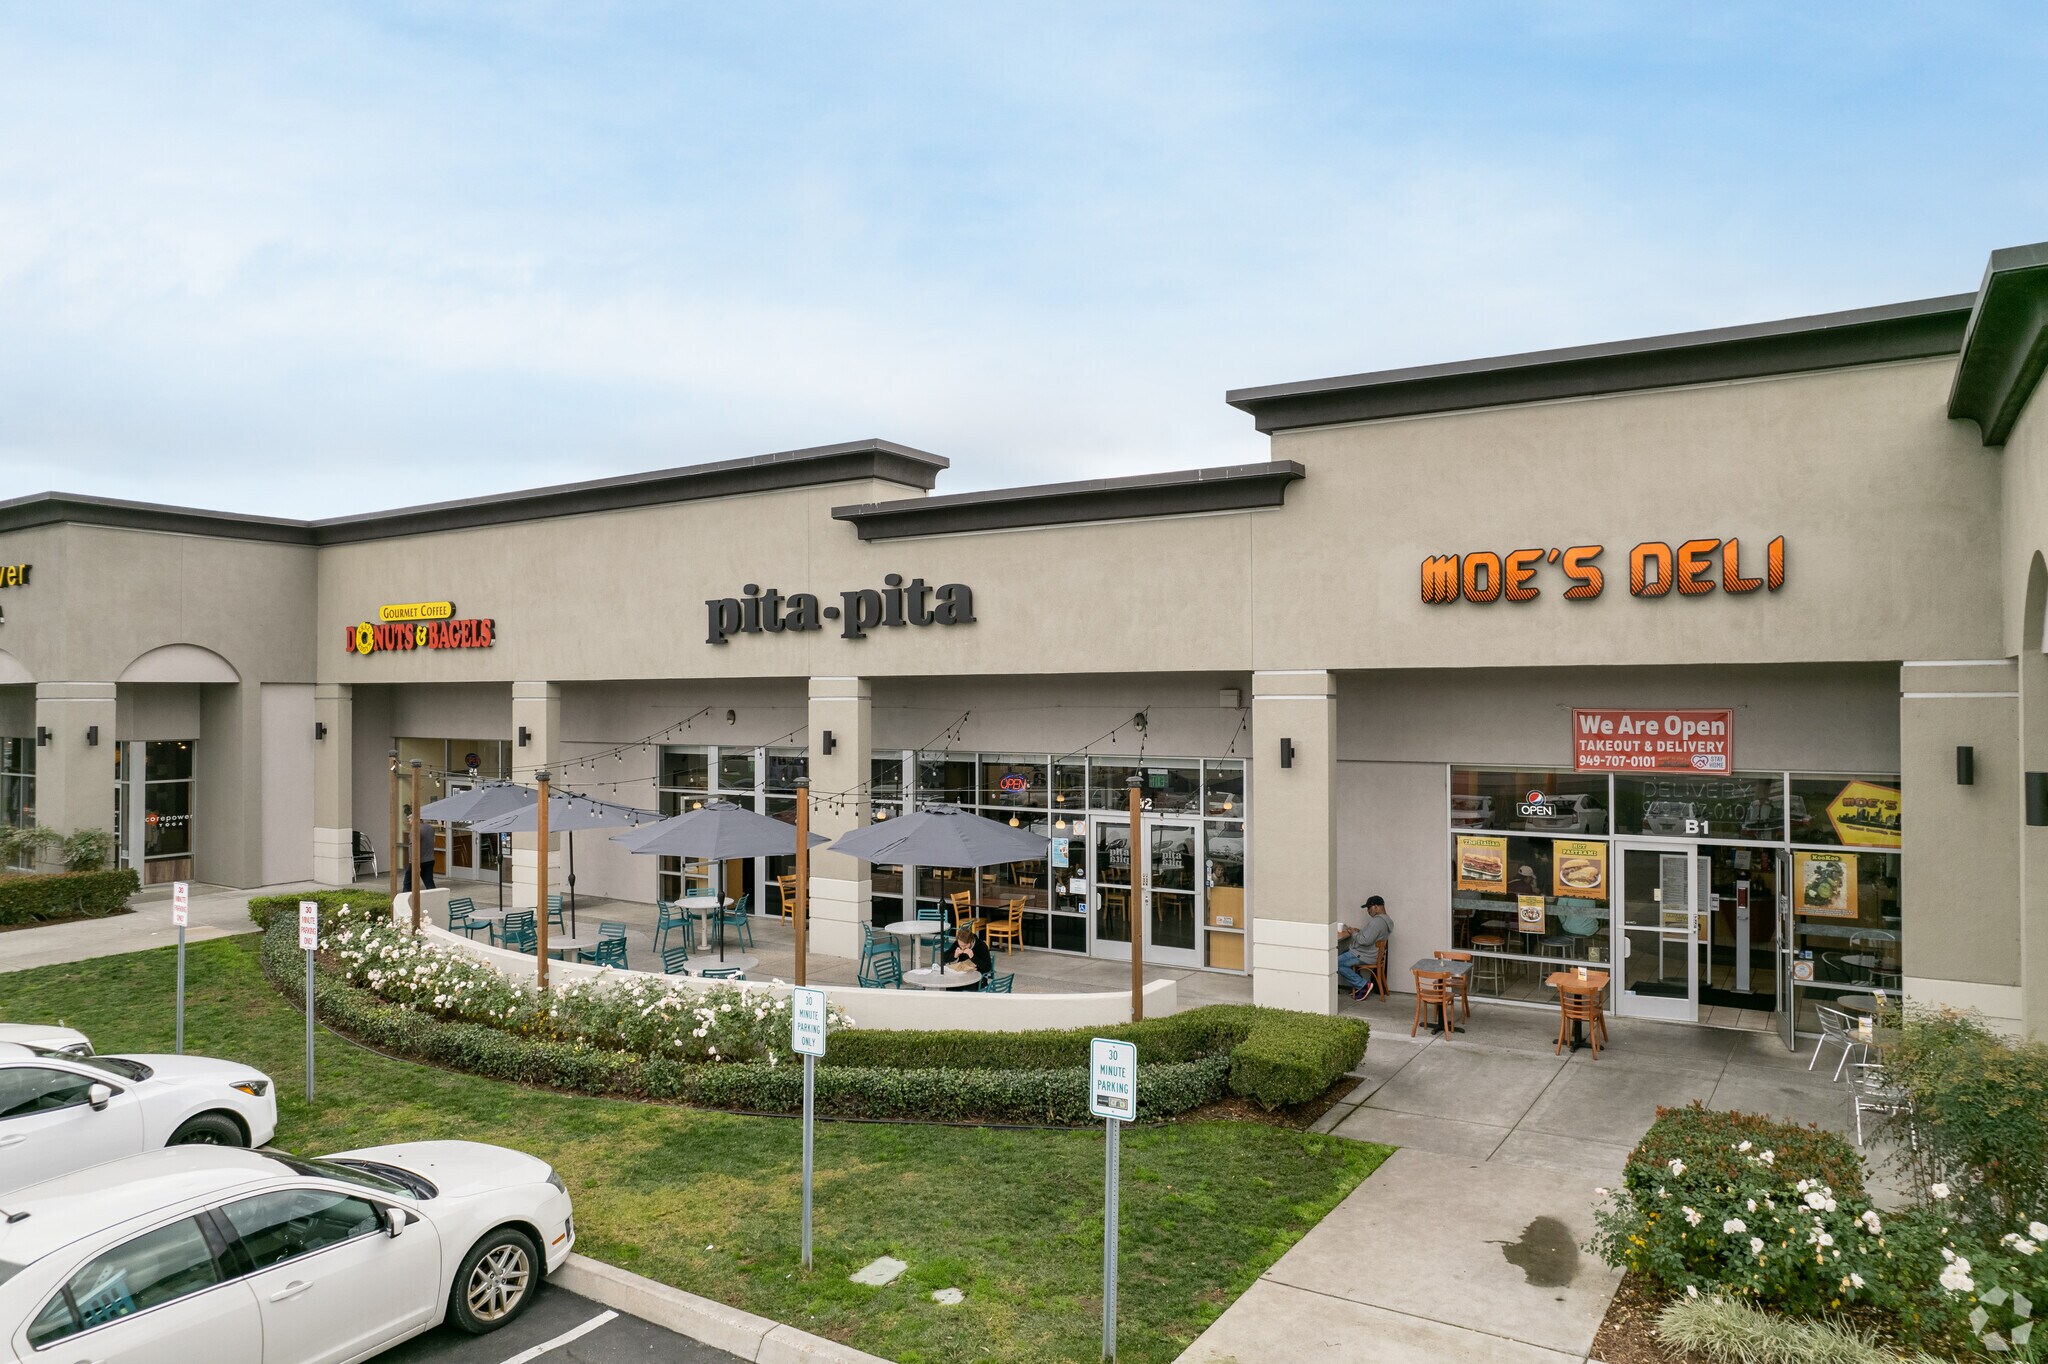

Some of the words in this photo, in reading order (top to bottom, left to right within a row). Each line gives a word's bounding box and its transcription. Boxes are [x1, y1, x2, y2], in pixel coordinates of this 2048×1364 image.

[1421, 543, 1605, 605] MOE'S
[1629, 534, 1785, 599] DELI
[383, 607, 418, 619] GOURMET
[420, 604, 447, 617] COFFEE
[346, 621, 415, 655] DONUTS
[428, 618, 493, 649] BAGELS
[1579, 715, 1614, 735] We
[1618, 715, 1659, 735] Are
[1664, 715, 1725, 740] Open
[1579, 740, 1641, 752] TAKEOUT
[1644, 741, 1653, 752] &
[1656, 741, 1725, 753] DELIVERY
[1579, 754, 1656, 768] 949-707-0101
[1000, 778, 1027, 790] OPEN
[1642, 781, 1752, 798] DELIVERY
[1521, 805, 1552, 816] OPEN
[1842, 797, 1898, 811] MOE'S
[145, 814, 193, 824] corepower
[1685, 819, 1709, 835] B1
[305, 906, 312, 914] 30
[805, 995, 813, 1006] 30
[799, 1009, 819, 1020] MINUTE
[797, 1022, 820, 1034] PARKING
[801, 1036, 816, 1047] ONLY
[1108, 1049, 1118, 1061] 30
[1100, 1064, 1126, 1078] MINUTE
[1097, 1079, 1129, 1094] PARKING
